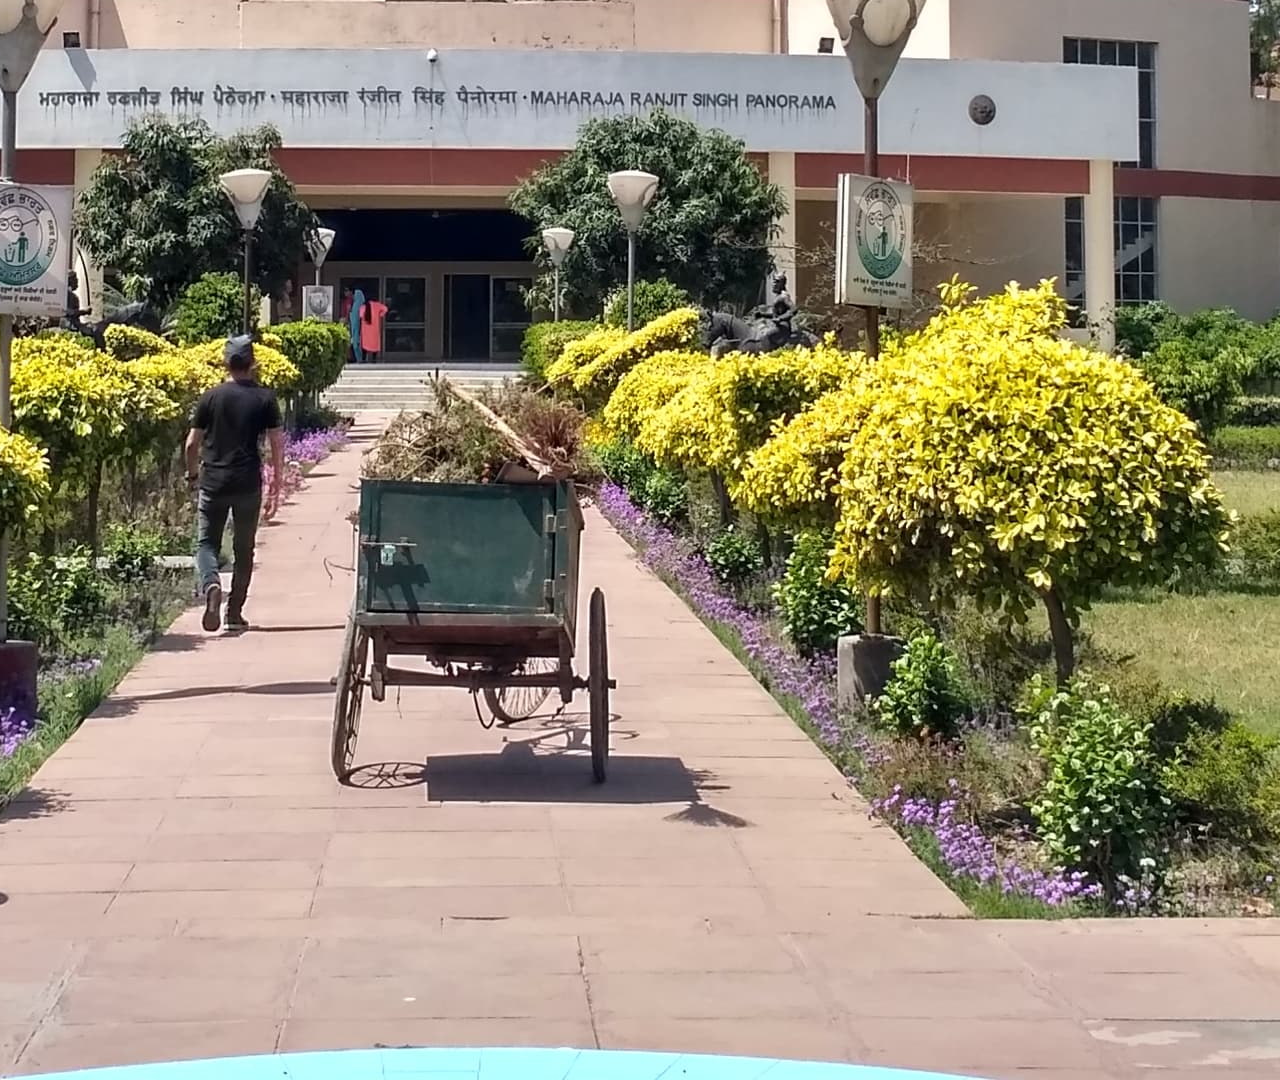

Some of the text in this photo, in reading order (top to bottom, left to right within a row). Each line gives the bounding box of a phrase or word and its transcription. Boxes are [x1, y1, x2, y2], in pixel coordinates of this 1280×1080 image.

[38, 84, 267, 108] ਮਹਾਰਾਜਾ ਰਣਜੀਤ ਸਿੰਘ ਪੈਨੋਰਮਾ
[280, 85, 518, 107] महाराजा रंजीत सिंह पैनोरमा
[529, 90, 837, 110] MAHARAJA RANJIT SINGH PANORAMA
